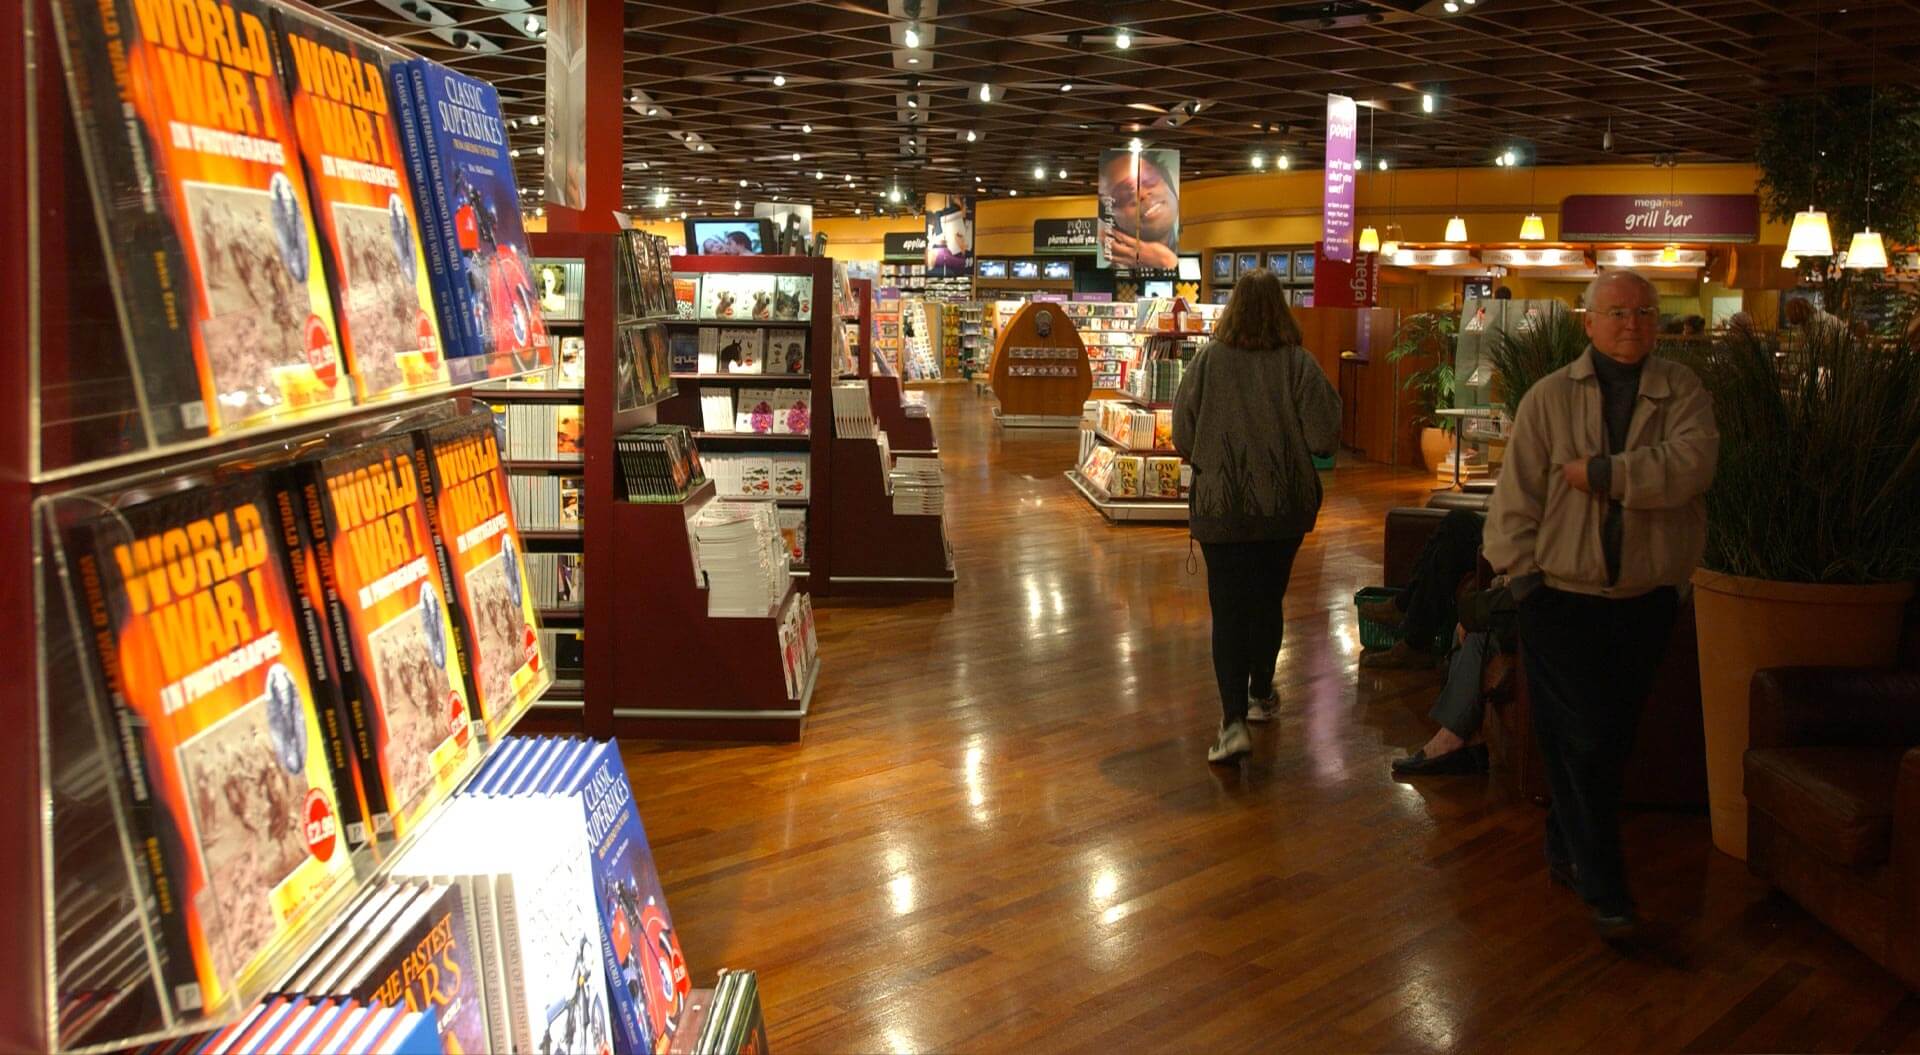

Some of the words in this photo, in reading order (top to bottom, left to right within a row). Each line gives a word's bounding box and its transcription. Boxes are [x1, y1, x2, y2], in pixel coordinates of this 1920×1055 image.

[133, 0, 273, 78] WORLD
[157, 47, 258, 135] WAR
[254, 77, 277, 139] I
[288, 33, 388, 115] WORLD
[445, 76, 486, 113] CLASSIC
[169, 120, 193, 149] IN
[190, 125, 287, 166] PHOTOGRAPHS
[311, 95, 380, 163] WAR
[375, 115, 393, 165] I
[438, 100, 503, 146] SUPERBIKES
[321, 154, 336, 177] IN
[333, 157, 399, 188] PHOTOGRAPHS
[1625, 211, 1659, 230] grill
[1664, 210, 1692, 227] bar
[433, 428, 499, 489] WORLD
[277, 490, 299, 546] WORLD
[304, 483, 325, 540] WORLD
[327, 454, 417, 532] WORLD
[449, 475, 495, 531] WAR
[490, 469, 503, 513] I
[348, 512, 411, 584] WAR
[406, 505, 422, 555] I
[416, 449, 432, 498] WORLD
[424, 496, 438, 527] WAR
[436, 545, 454, 604] PHOTOGRAPHS
[114, 504, 268, 615] WORLD
[290, 550, 306, 583] WAR
[316, 541, 333, 577] WAR
[358, 584, 374, 610] IN
[370, 556, 429, 604] PHOTOGRAPHS
[301, 596, 311, 609] IN
[327, 589, 337, 602] IN
[150, 580, 251, 679] WAR
[247, 567, 272, 634] I
[304, 607, 327, 681] PHOTOGRAPHS
[330, 602, 352, 672] PHOTOGRAPHS
[160, 682, 185, 715] IN
[180, 631, 282, 704] PHOTOGRAPHS
[584, 759, 614, 811] CLASSIC
[307, 814, 335, 845] £2.99
[586, 772, 630, 854] SUPERBIKES
[478, 894, 489, 917] THE
[501, 893, 513, 917] THE
[370, 970, 402, 1008] THE
[402, 912, 454, 988] FASTEST
[481, 919, 495, 967] HISTORY
[504, 918, 519, 965] HISTORY
[404, 939, 462, 1013] ARS
[487, 970, 497, 984] OF
[511, 968, 522, 983] OF
[608, 956, 622, 988] WORLD
[488, 986, 503, 1031] BRITISH
[513, 985, 528, 1030] BRITISH
